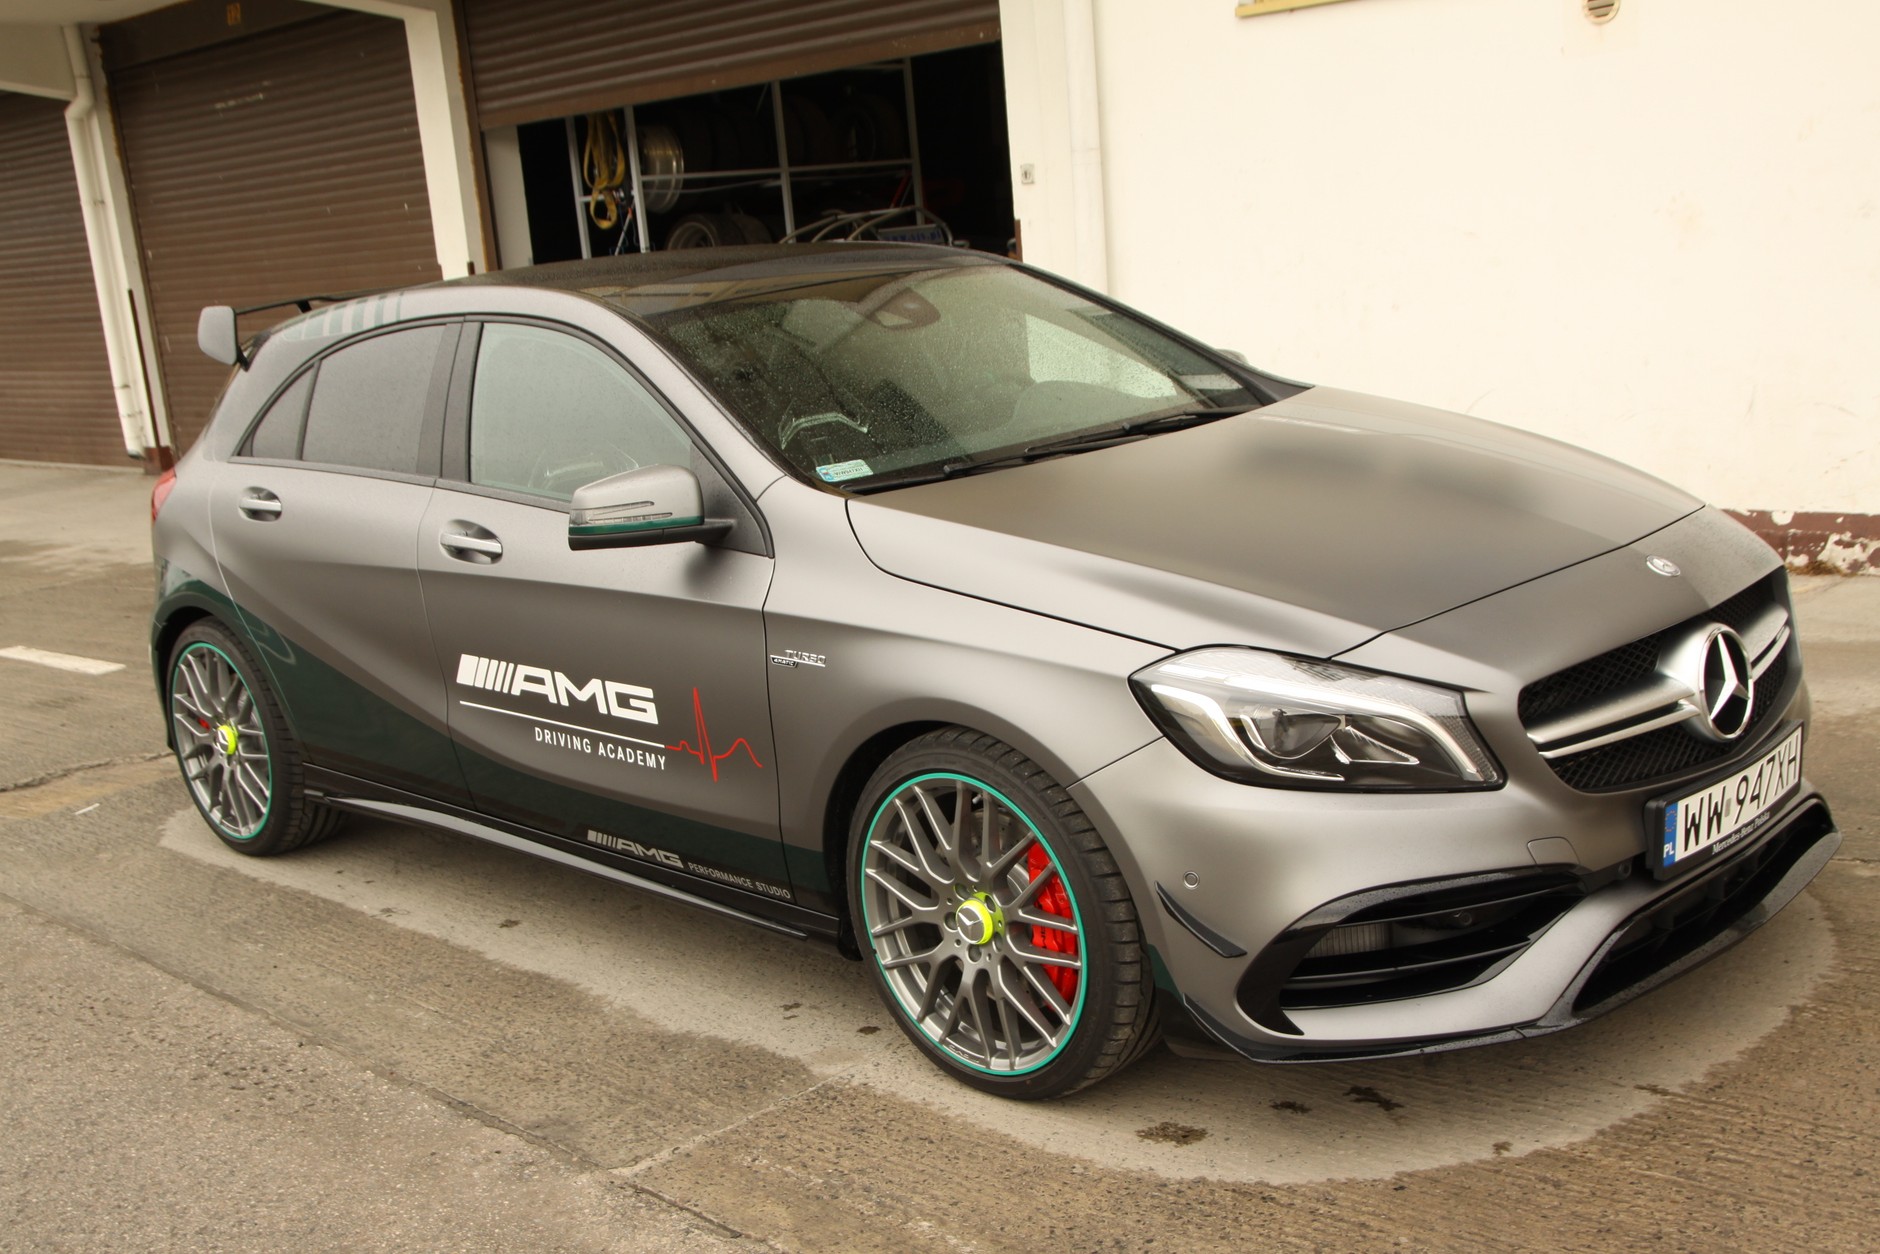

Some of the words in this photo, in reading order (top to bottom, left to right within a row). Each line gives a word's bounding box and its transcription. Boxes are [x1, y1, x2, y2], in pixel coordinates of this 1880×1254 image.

[784, 649, 826, 664] TURBO
[511, 664, 659, 725] AMG
[534, 726, 591, 754] DRIVING
[598, 741, 666, 770] ACADEMY
[1684, 786, 1726, 852] WW
[1733, 734, 1799, 825] 947XH
[617, 838, 684, 868] AMG
[688, 862, 753, 889] PERFORMANCE
[755, 881, 791, 899] STUDIO
[1663, 842, 1675, 858] PL
